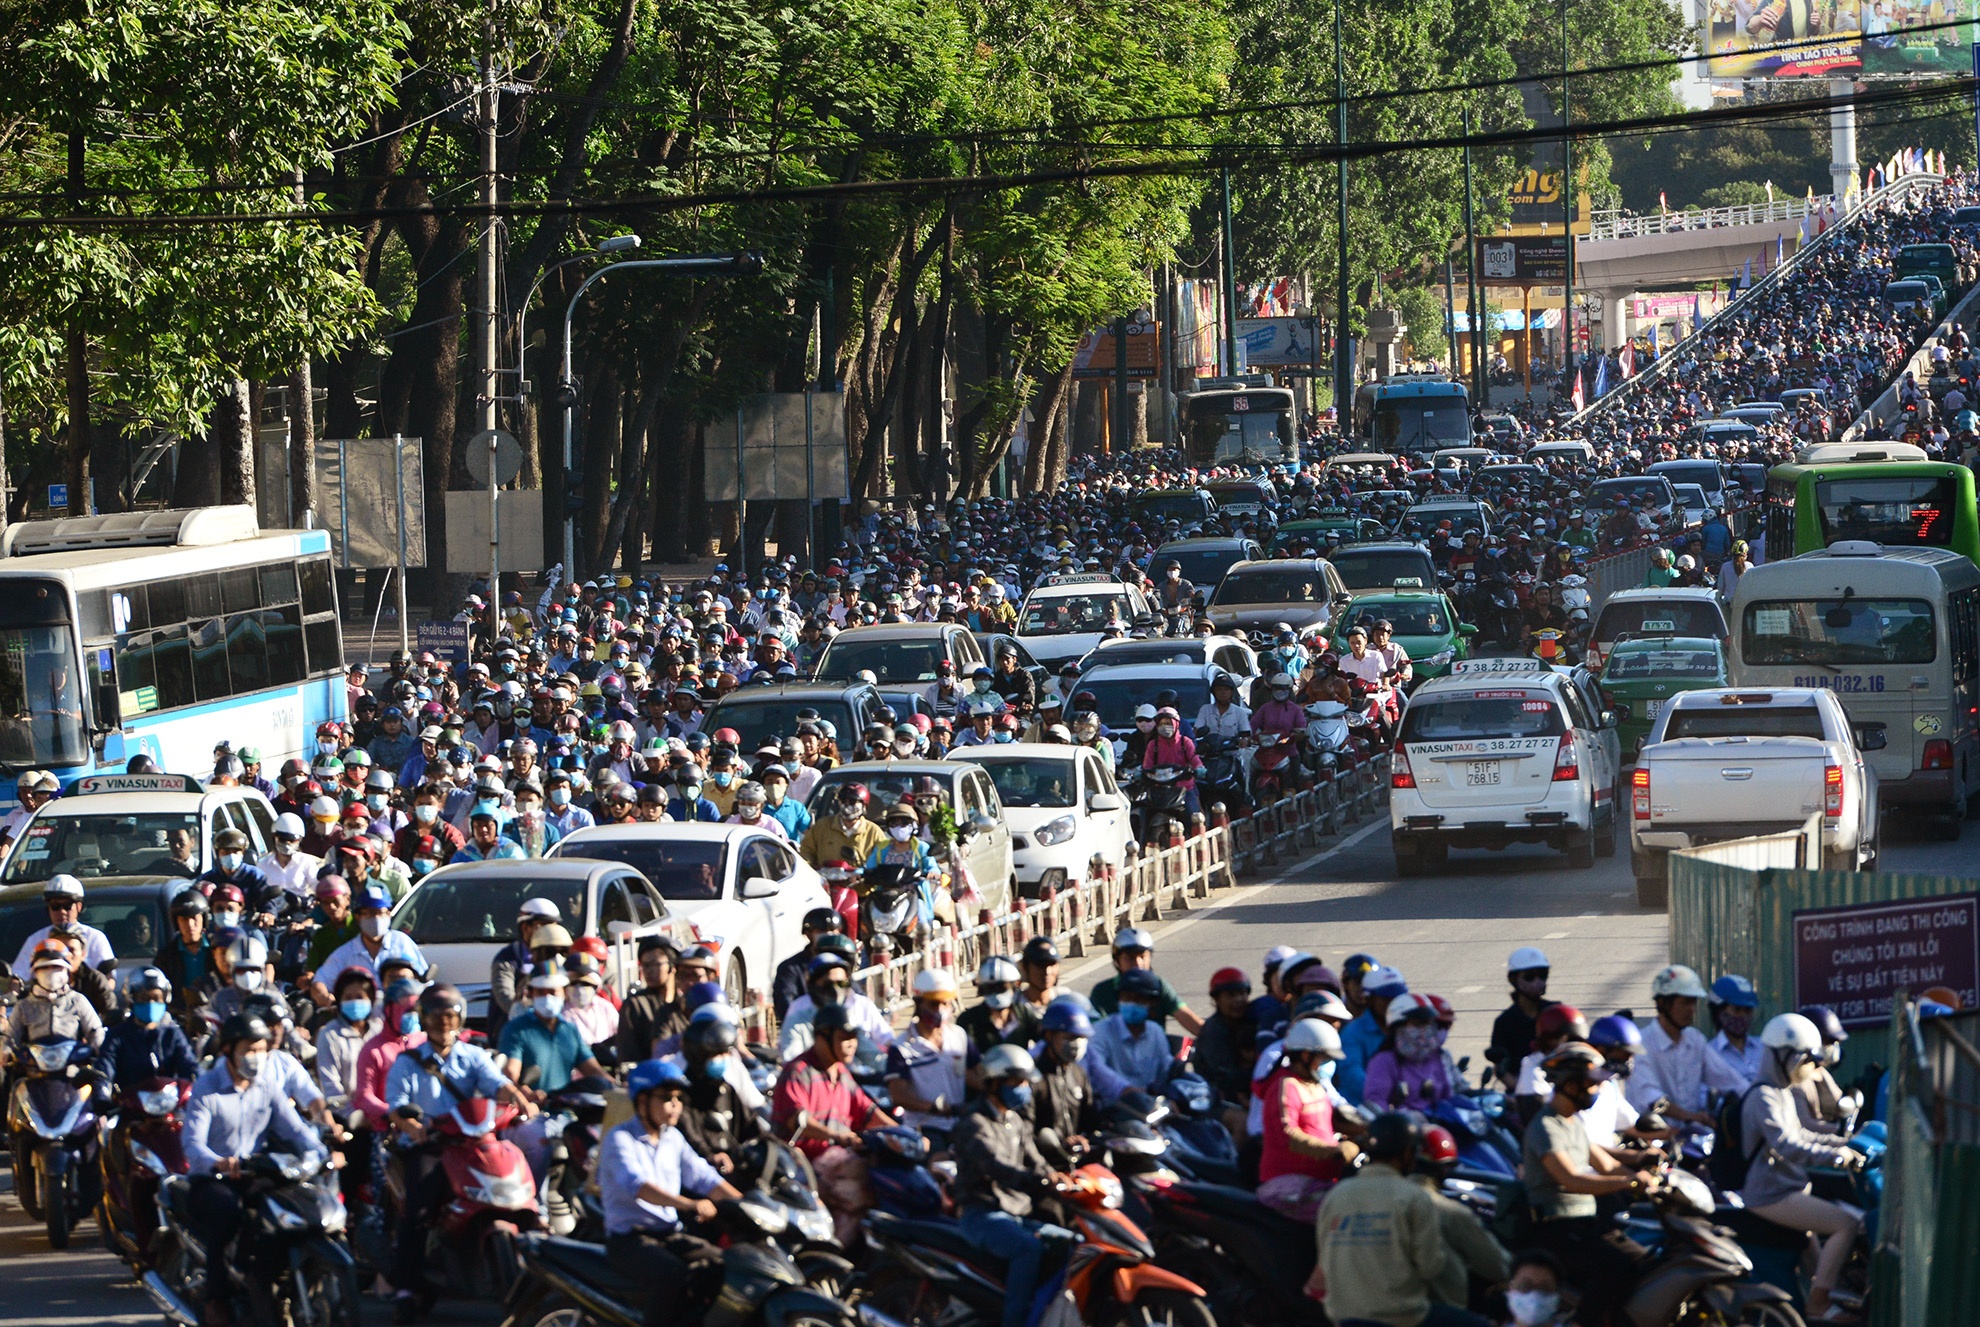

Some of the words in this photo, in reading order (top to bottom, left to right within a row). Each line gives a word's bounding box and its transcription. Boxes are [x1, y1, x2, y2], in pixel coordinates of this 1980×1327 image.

[1490, 252, 1507, 263] 003
[1235, 397, 1248, 411] 55
[1912, 510, 1940, 537] 7
[1648, 621, 1668, 630] TAXI
[1508, 663, 1521, 671] 27
[1523, 662, 1537, 671] 27
[1522, 702, 1548, 711] 10094
[1491, 740, 1522, 750] 38.27
[1525, 740, 1538, 749] 27
[1542, 739, 1555, 748] 27
[1474, 763, 1491, 773] 51F
[1803, 921, 1837, 941] CÔNG
[1840, 918, 1874, 937] TRÌNH
[1876, 916, 1909, 934] ĐANG
[1911, 913, 1931, 929] THI
[1933, 908, 1967, 928] CÔNG
[1832, 943, 1874, 965] CHÚNG
[1875, 940, 1896, 961] TÔI
[1898, 941, 1917, 958] XIN
[1919, 932, 1940, 957] LỖI
[1864, 965, 1889, 988] BẤT
[1891, 964, 1918, 987] TIỆN
[1920, 961, 1945, 982] NÀY
[1840, 999, 1866, 1017] FOR
